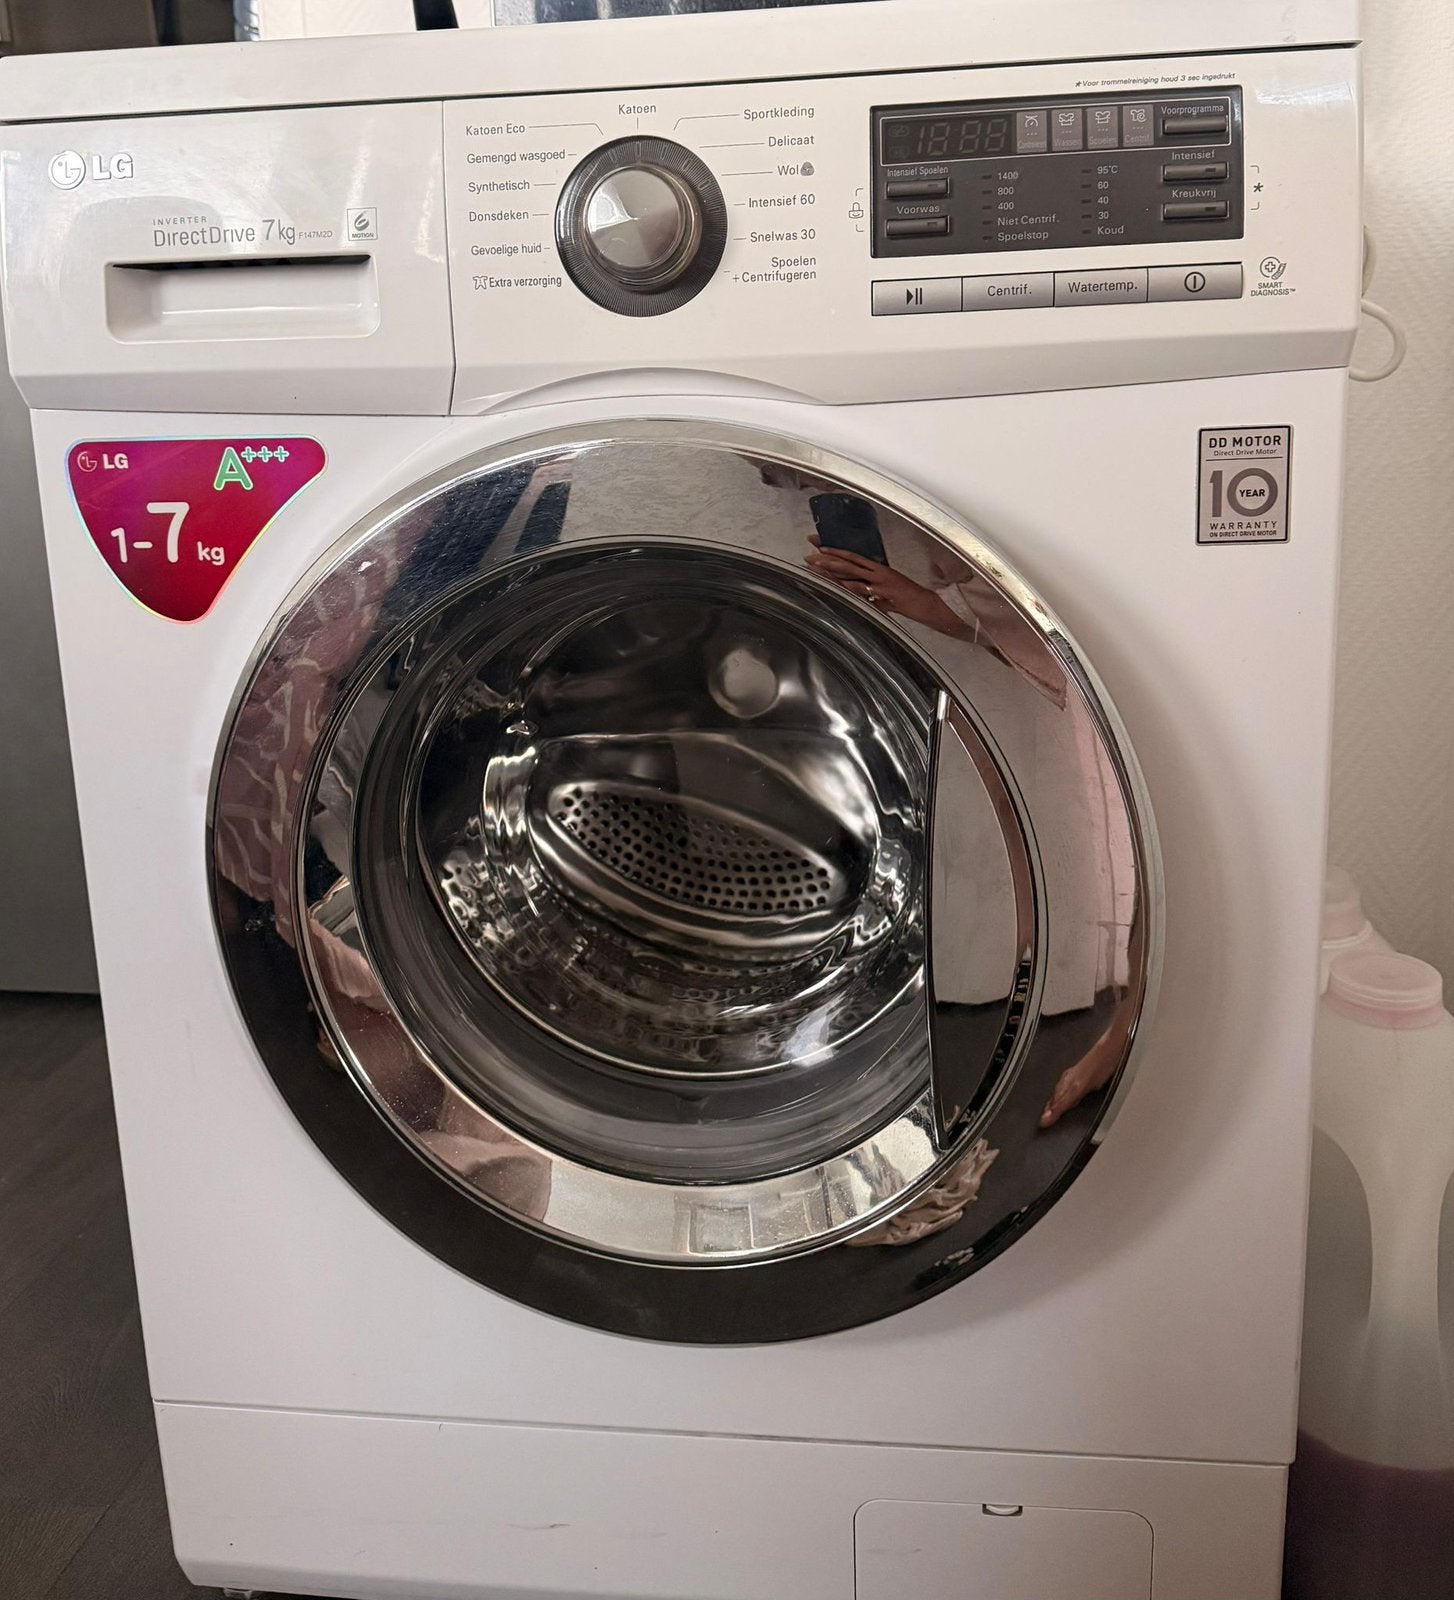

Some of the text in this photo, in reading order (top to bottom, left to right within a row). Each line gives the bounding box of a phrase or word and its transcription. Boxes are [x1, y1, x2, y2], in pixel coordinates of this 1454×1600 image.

[1101, 76, 1159, 86] trommelreiniging
[1160, 75, 1178, 83] houd
[1201, 72, 1236, 81] ingedrukt
[618, 103, 657, 115] Katoen
[743, 106, 815, 122] Sportkleding
[1161, 104, 1224, 116] Voorprogramma
[465, 123, 526, 136] Katoen Eco
[768, 135, 815, 147] Delicaat
[466, 149, 566, 165] Gemengd wasgoed
[1171, 150, 1216, 161] Intensief
[92, 152, 135, 181] LG
[777, 165, 799, 176] Wol
[887, 165, 949, 178] Intensief Spoelen
[997, 171, 1019, 180] 1400
[468, 180, 530, 194] Synthetisch
[1097, 181, 1109, 189] 60
[997, 187, 1014, 196] 800
[1172, 189, 1217, 199] Kreukvrij
[748, 193, 816, 208] Intensief 60
[997, 202, 1015, 210] 400
[1097, 196, 1109, 205] 40
[896, 204, 940, 215] Voorwas
[1098, 211, 1109, 220] 30
[152, 216, 208, 226] INVERTER
[469, 211, 529, 222] Donsdeken
[997, 214, 1060, 227] Niet Centrif.
[750, 228, 816, 243] Snelwas 30
[997, 231, 1049, 242] Spoelstop
[1097, 226, 1124, 235] Koud
[471, 243, 542, 257] Gevoelige huid
[771, 256, 817, 269] Spoelen
[489, 275, 562, 288] Extra verzorging
[1068, 280, 1139, 294] Watertemp.
[1257, 281, 1283, 290] SMART
[987, 284, 1033, 298] Centrif.
[1209, 435, 1282, 449] DD MOTOR
[102, 453, 129, 470] LG
[1209, 467, 1279, 518] 10
[1239, 488, 1266, 498] YEAR
[1209, 520, 1278, 531] WARRANTY
[196, 541, 225, 566] kg
